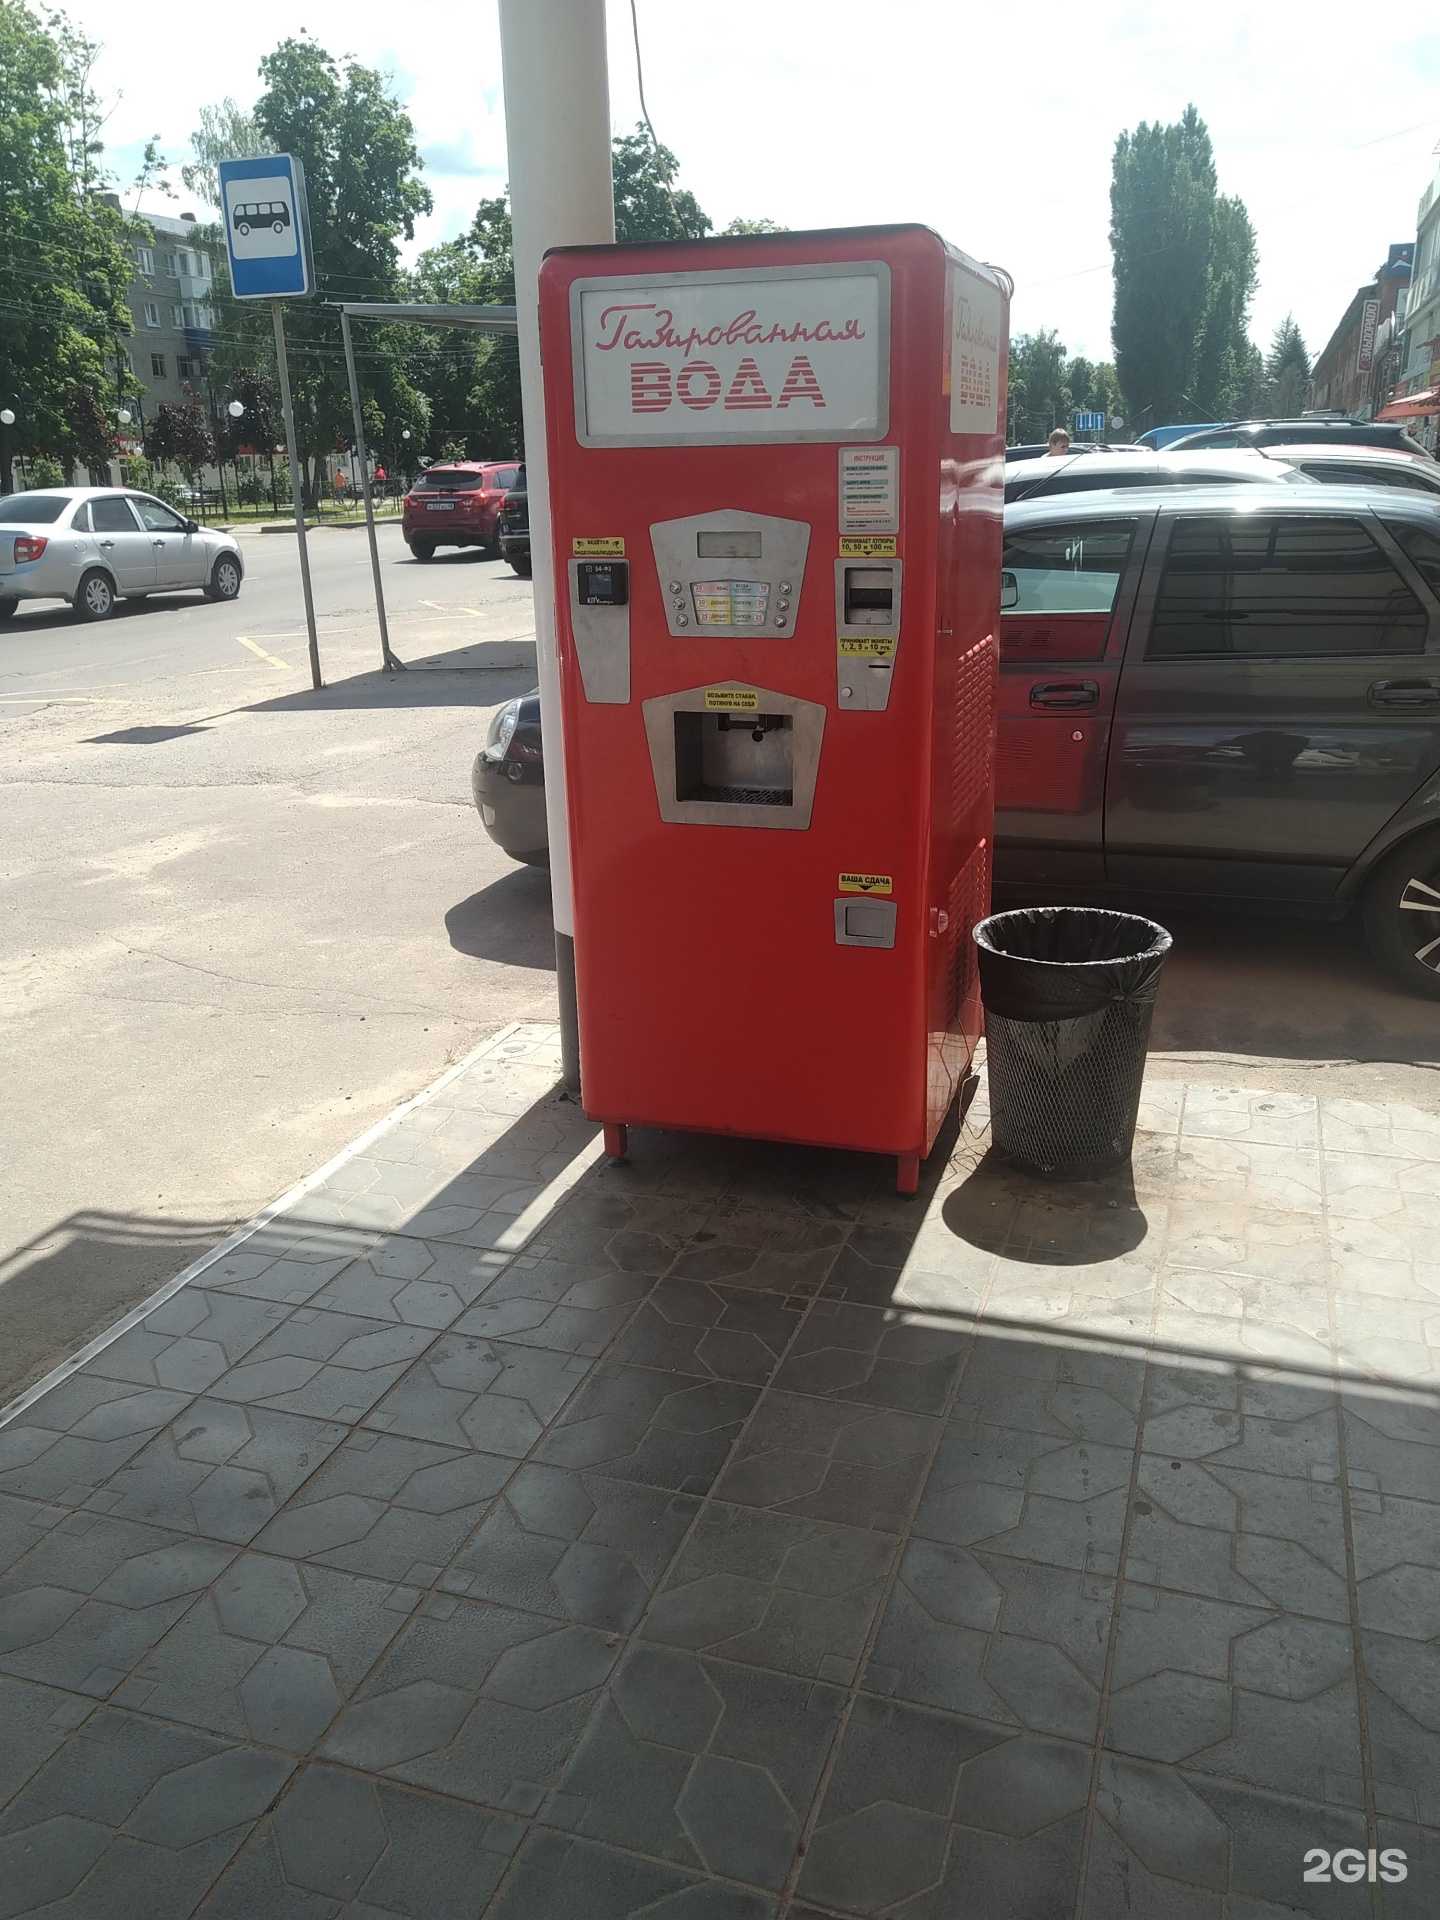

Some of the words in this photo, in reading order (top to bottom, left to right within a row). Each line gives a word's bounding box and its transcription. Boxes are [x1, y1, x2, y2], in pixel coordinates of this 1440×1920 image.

[595, 303, 865, 356] Газированная
[630, 355, 827, 414] ВОДА
[841, 875, 863, 883] ВАША
[864, 876, 890, 885] СДАЧА
